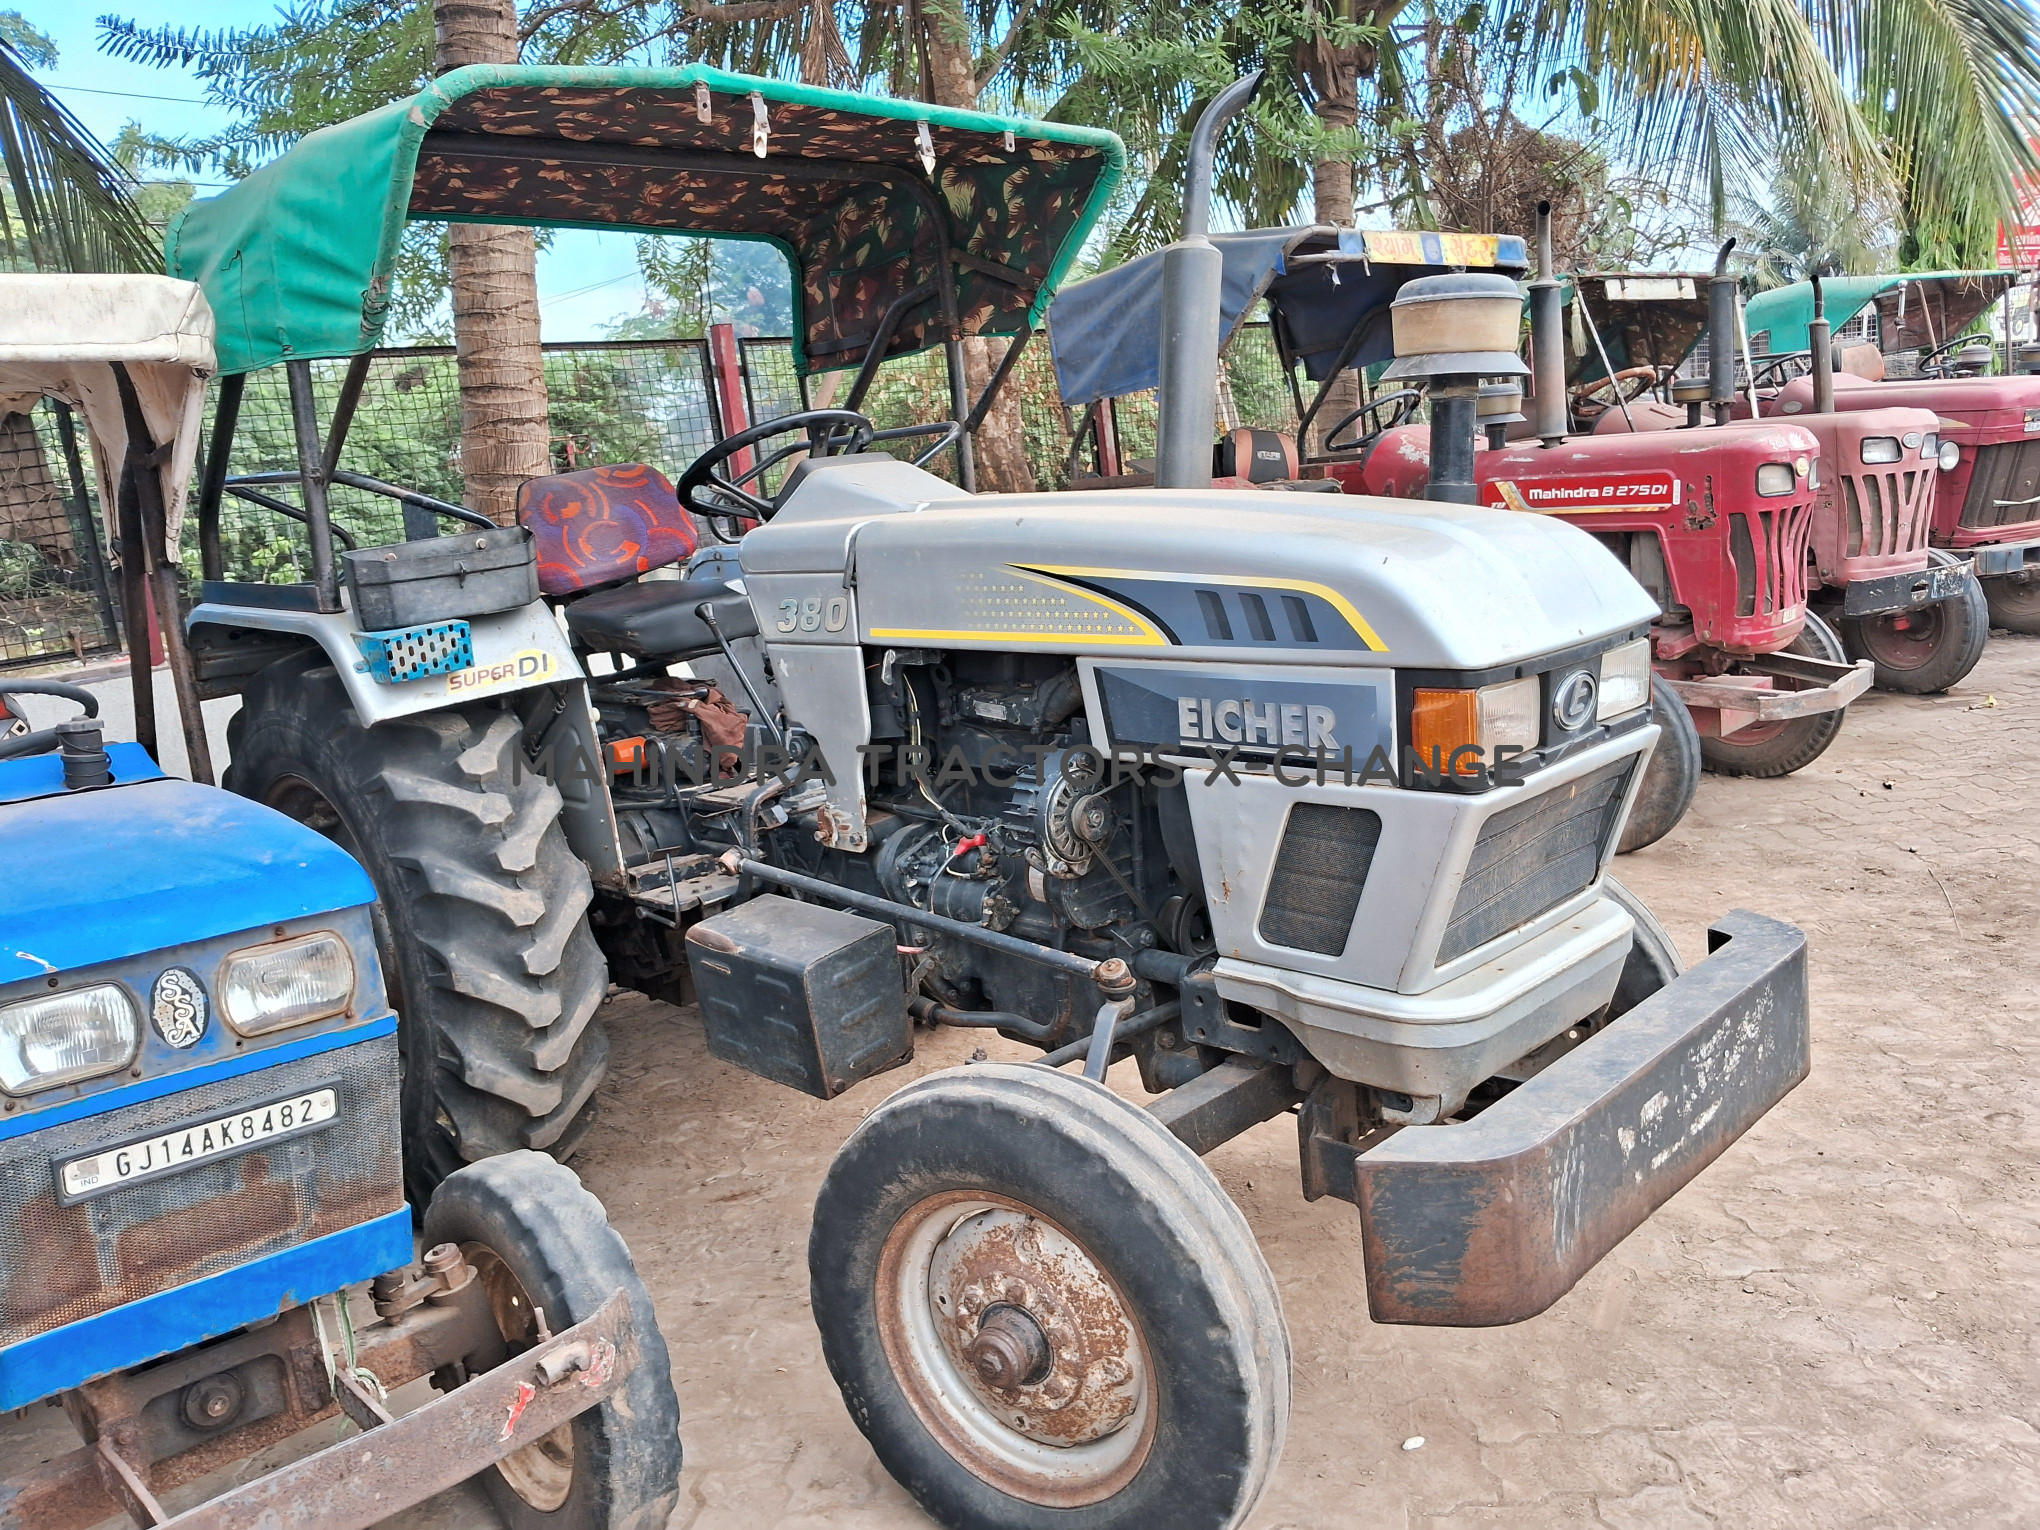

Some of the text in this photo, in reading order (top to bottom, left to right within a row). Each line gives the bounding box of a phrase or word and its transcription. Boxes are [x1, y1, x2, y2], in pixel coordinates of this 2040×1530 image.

[1529, 488, 1599, 500] Mahindra
[1602, 486, 1613, 497] B
[776, 597, 849, 633] 380
[518, 653, 549, 678] DI
[1177, 696, 1341, 750] EICHER
[116, 1099, 314, 1177] GJ14AK8482
[80, 1175, 99, 1188] IND
